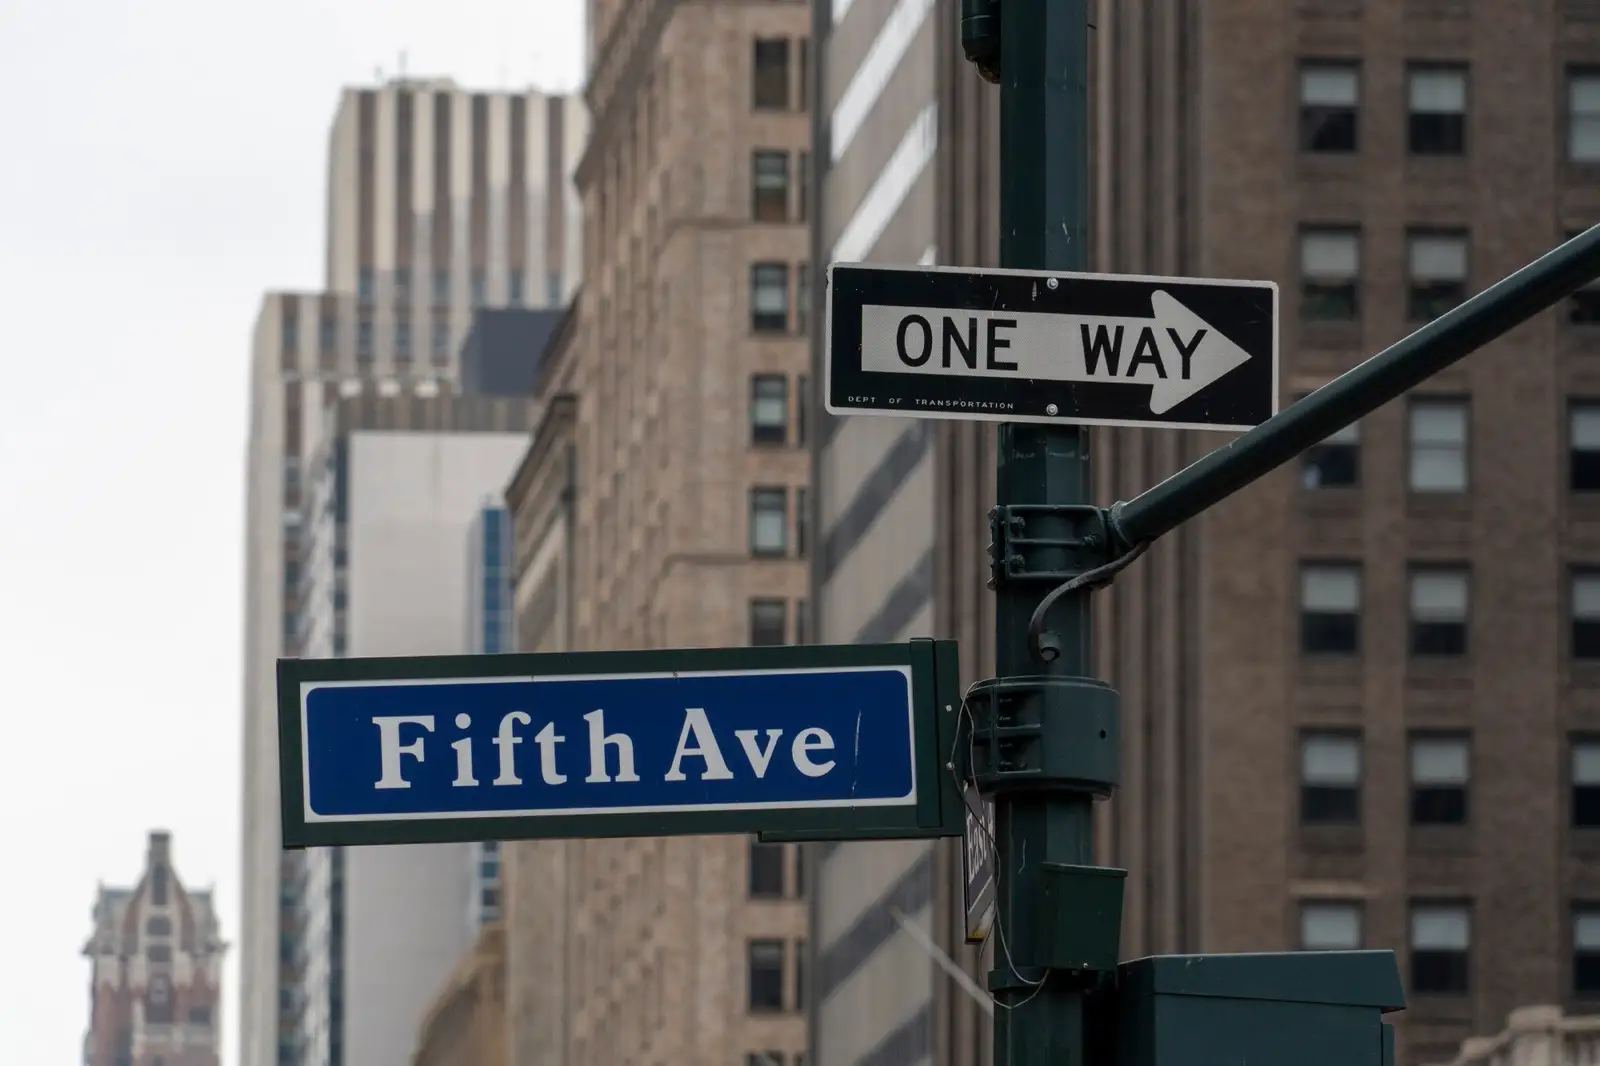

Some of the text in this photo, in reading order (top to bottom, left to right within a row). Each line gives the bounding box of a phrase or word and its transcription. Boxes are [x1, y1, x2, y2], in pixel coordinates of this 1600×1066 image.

[896, 314, 1207, 379] ONE WAY
[888, 397, 903, 405] OF
[915, 398, 1014, 409] TRANSPORTATION
[371, 708, 836, 789] Fifth Ave
[967, 814, 986, 884] East
